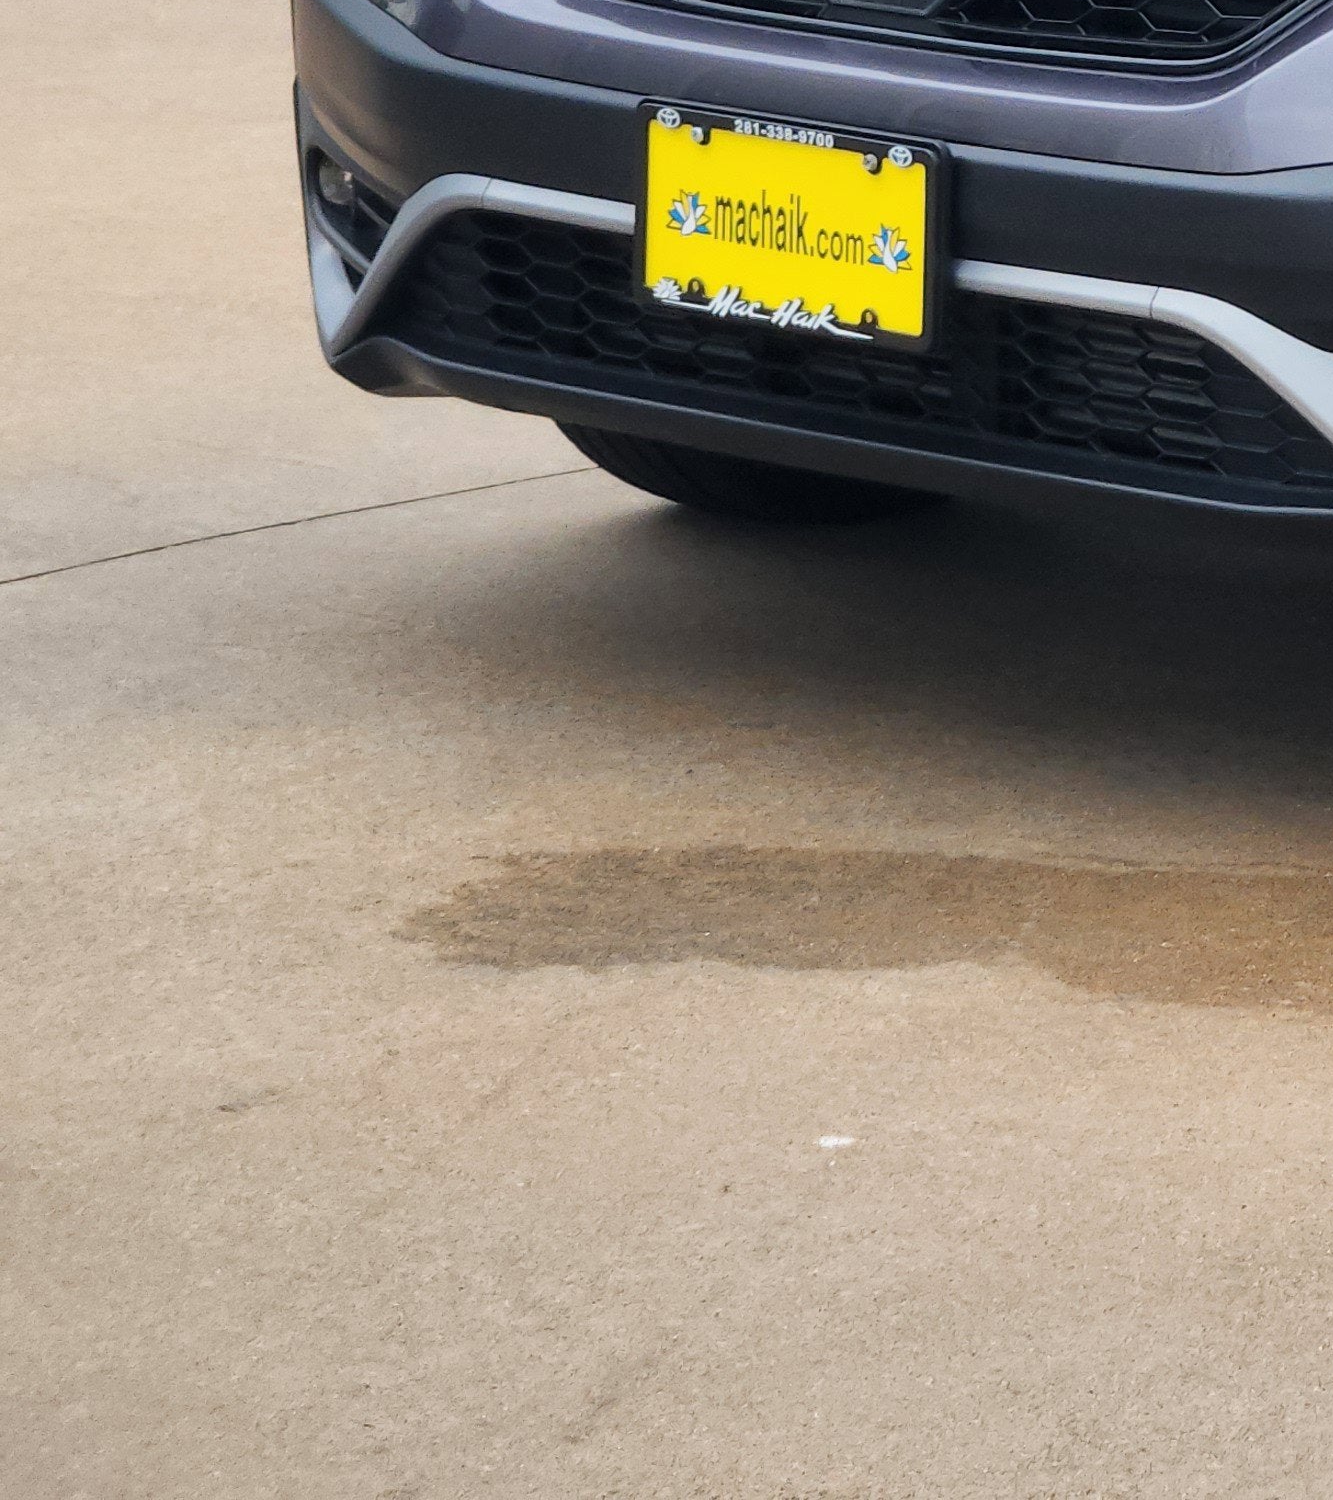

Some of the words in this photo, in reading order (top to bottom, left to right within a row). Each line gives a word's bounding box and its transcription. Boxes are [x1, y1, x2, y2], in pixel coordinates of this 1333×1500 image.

[713, 189, 865, 266] machaik.com
[707, 284, 767, 319] Mac
[770, 298, 841, 332] Haik
